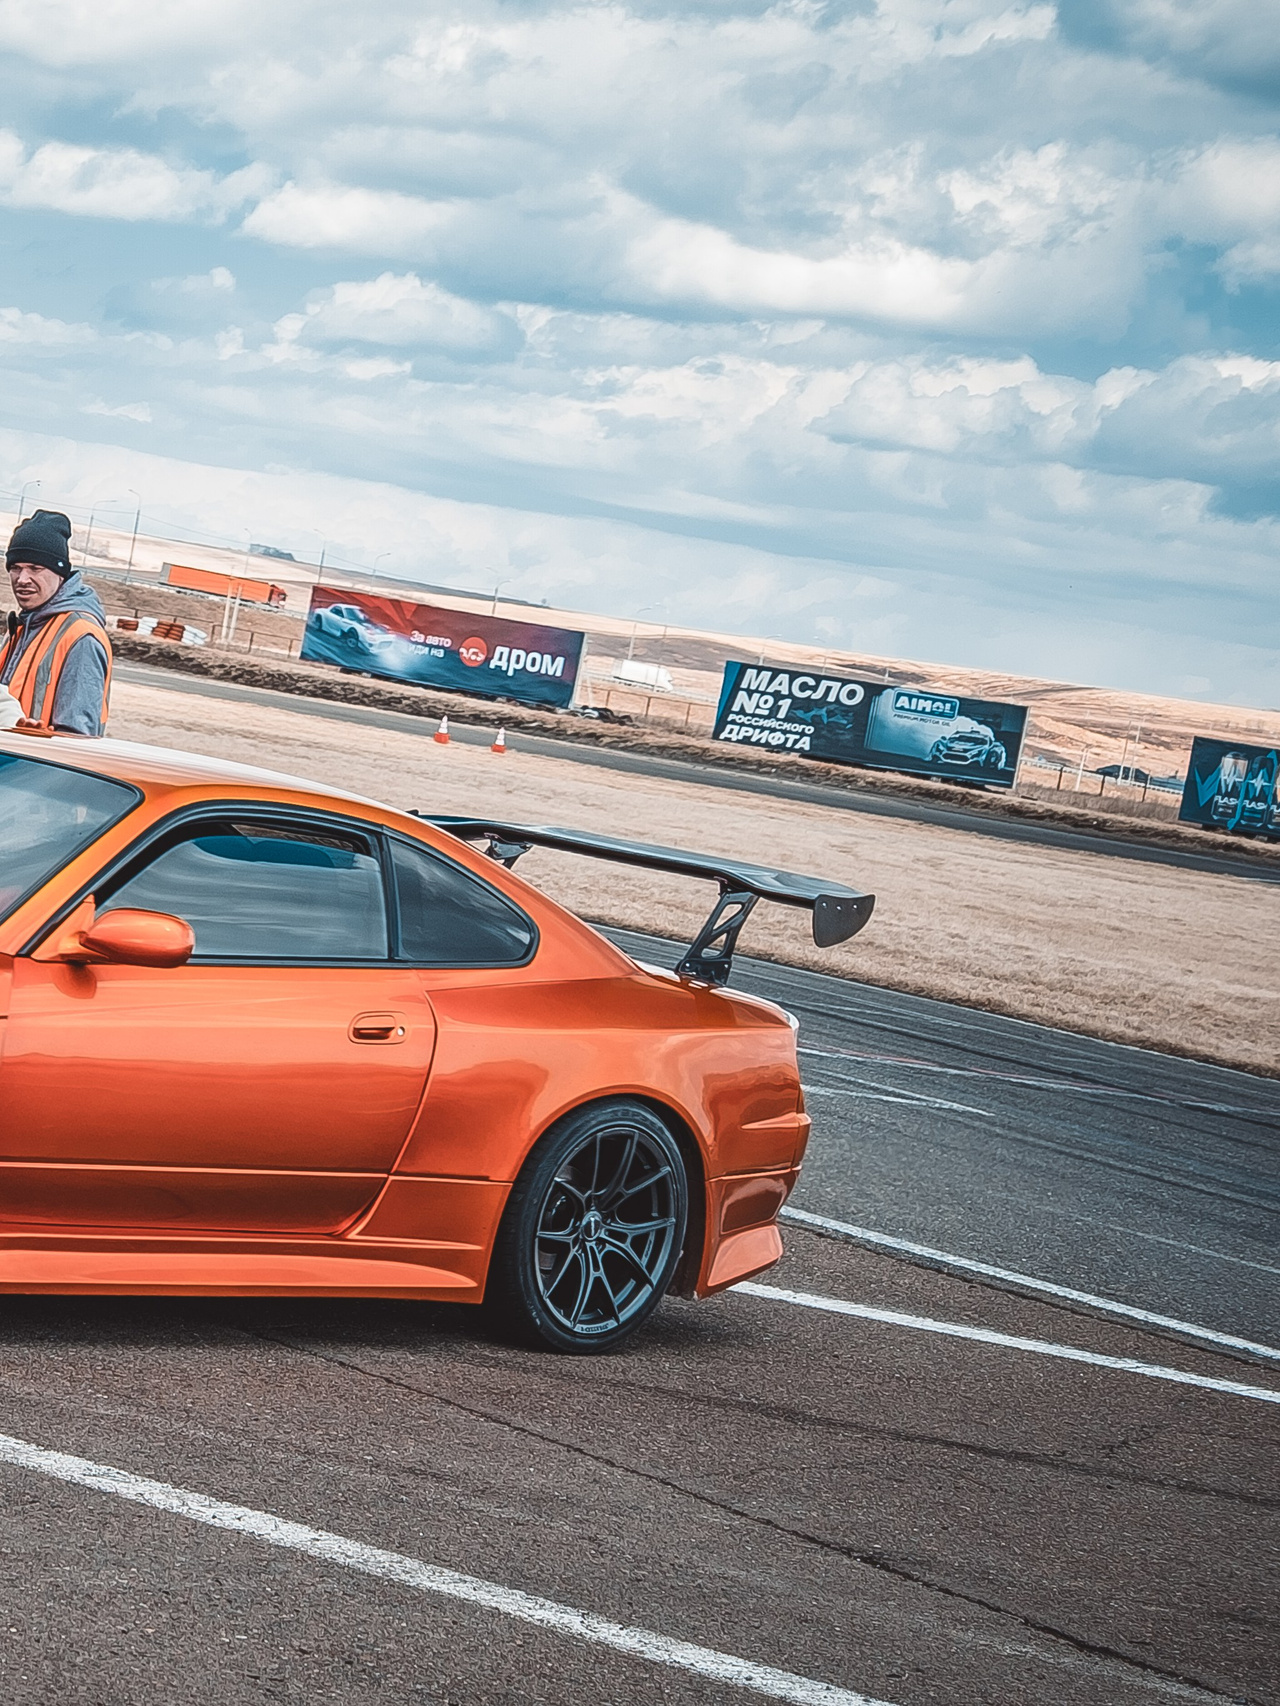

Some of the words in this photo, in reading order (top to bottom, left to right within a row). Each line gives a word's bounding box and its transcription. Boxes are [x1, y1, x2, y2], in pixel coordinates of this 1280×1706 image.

[409, 630, 424, 643] За
[425, 634, 452, 647] авто
[430, 647, 445, 658] на
[740, 668, 865, 706] МАСЛО
[895, 695, 954, 714] AIMOL
[727, 713, 815, 735] РОССИЙСКОГО
[719, 724, 811, 751] ДРИФТА
[1214, 795, 1239, 805] FLAS
